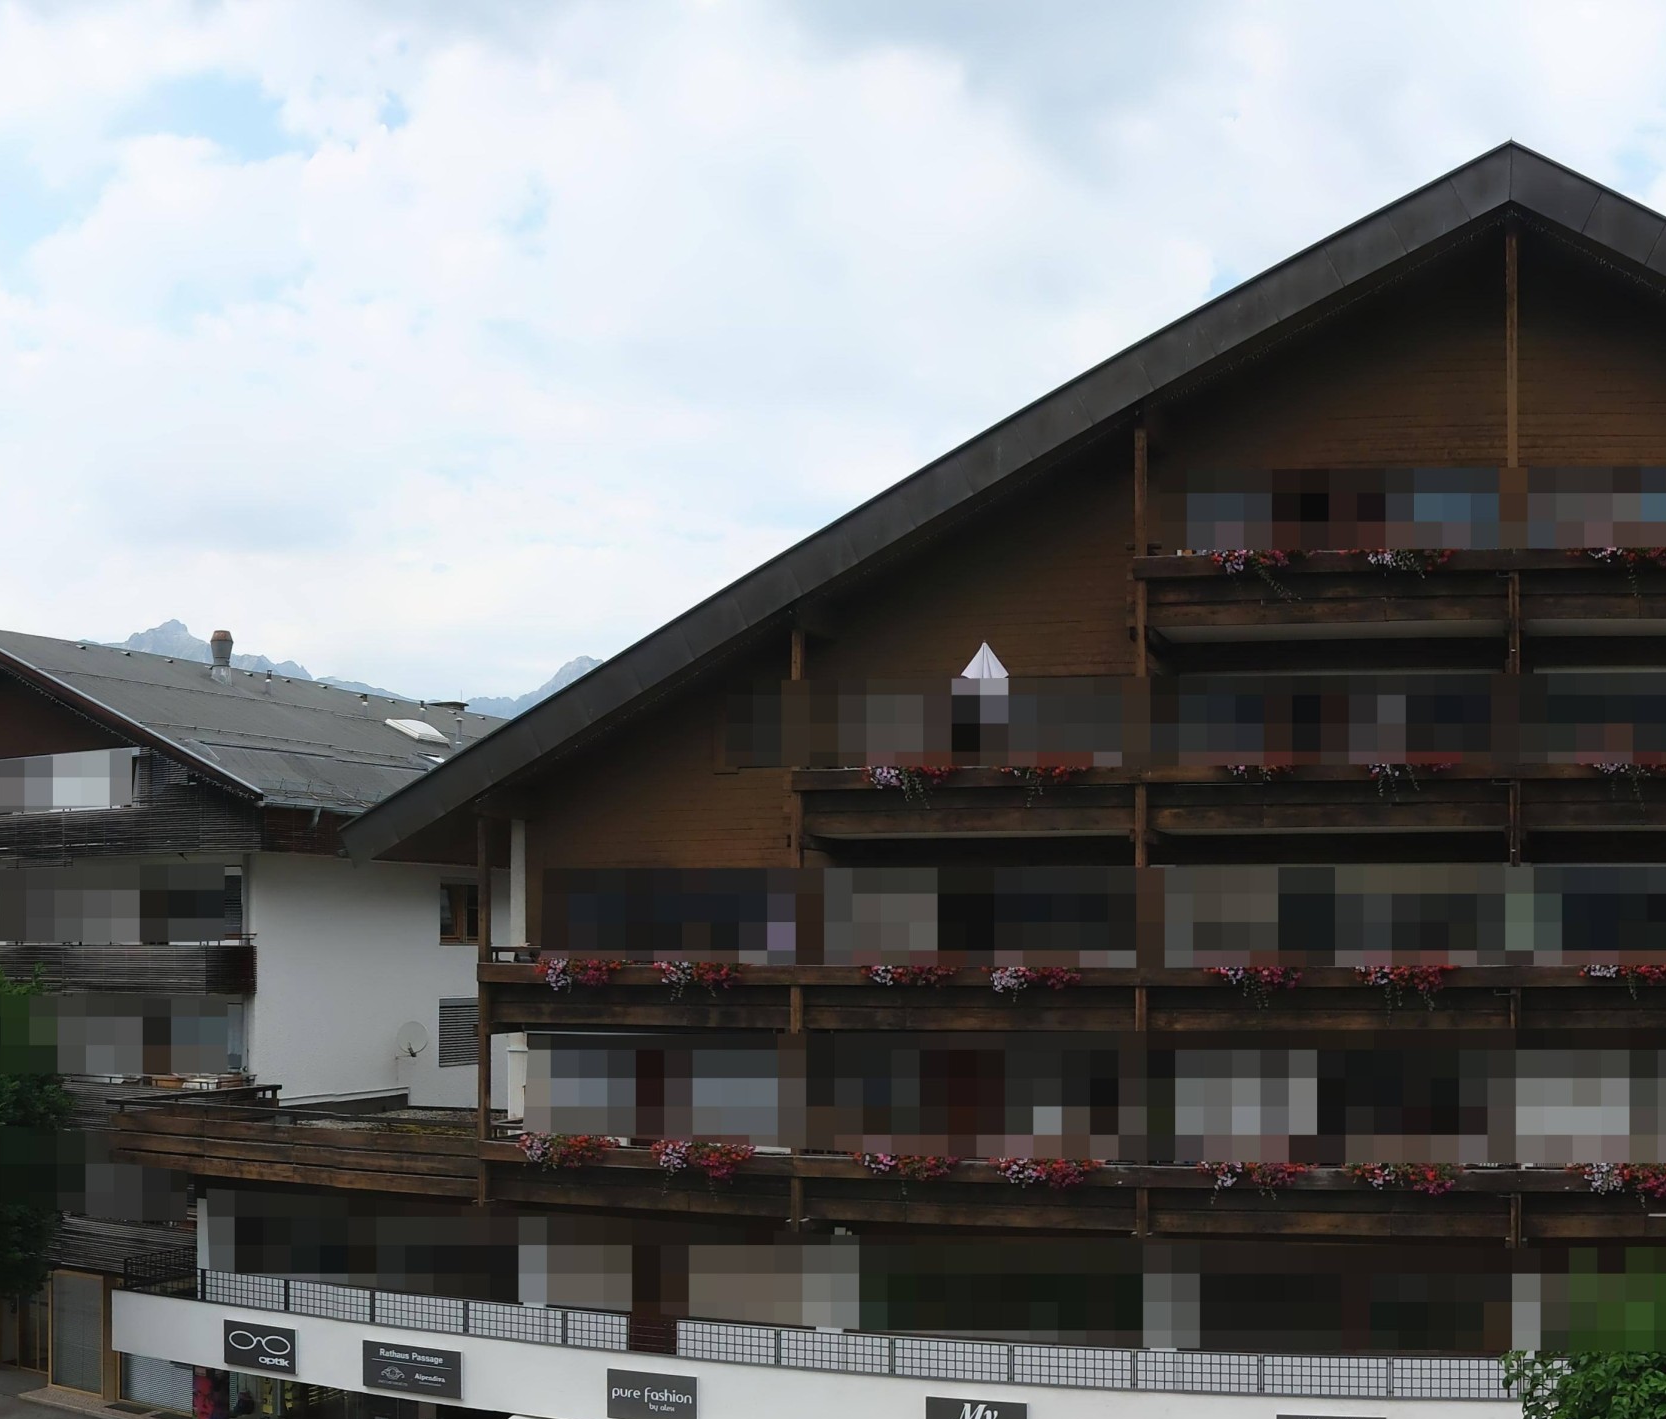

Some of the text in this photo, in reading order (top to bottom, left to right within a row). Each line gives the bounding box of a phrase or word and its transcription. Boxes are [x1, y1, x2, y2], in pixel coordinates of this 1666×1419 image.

[258, 1355, 291, 1368] optik
[379, 1348, 444, 1366] Rathaus Passage
[414, 1373, 446, 1383] Alpendiva
[612, 1386, 693, 1405] pure fashion
[648, 1402, 659, 1412] by
